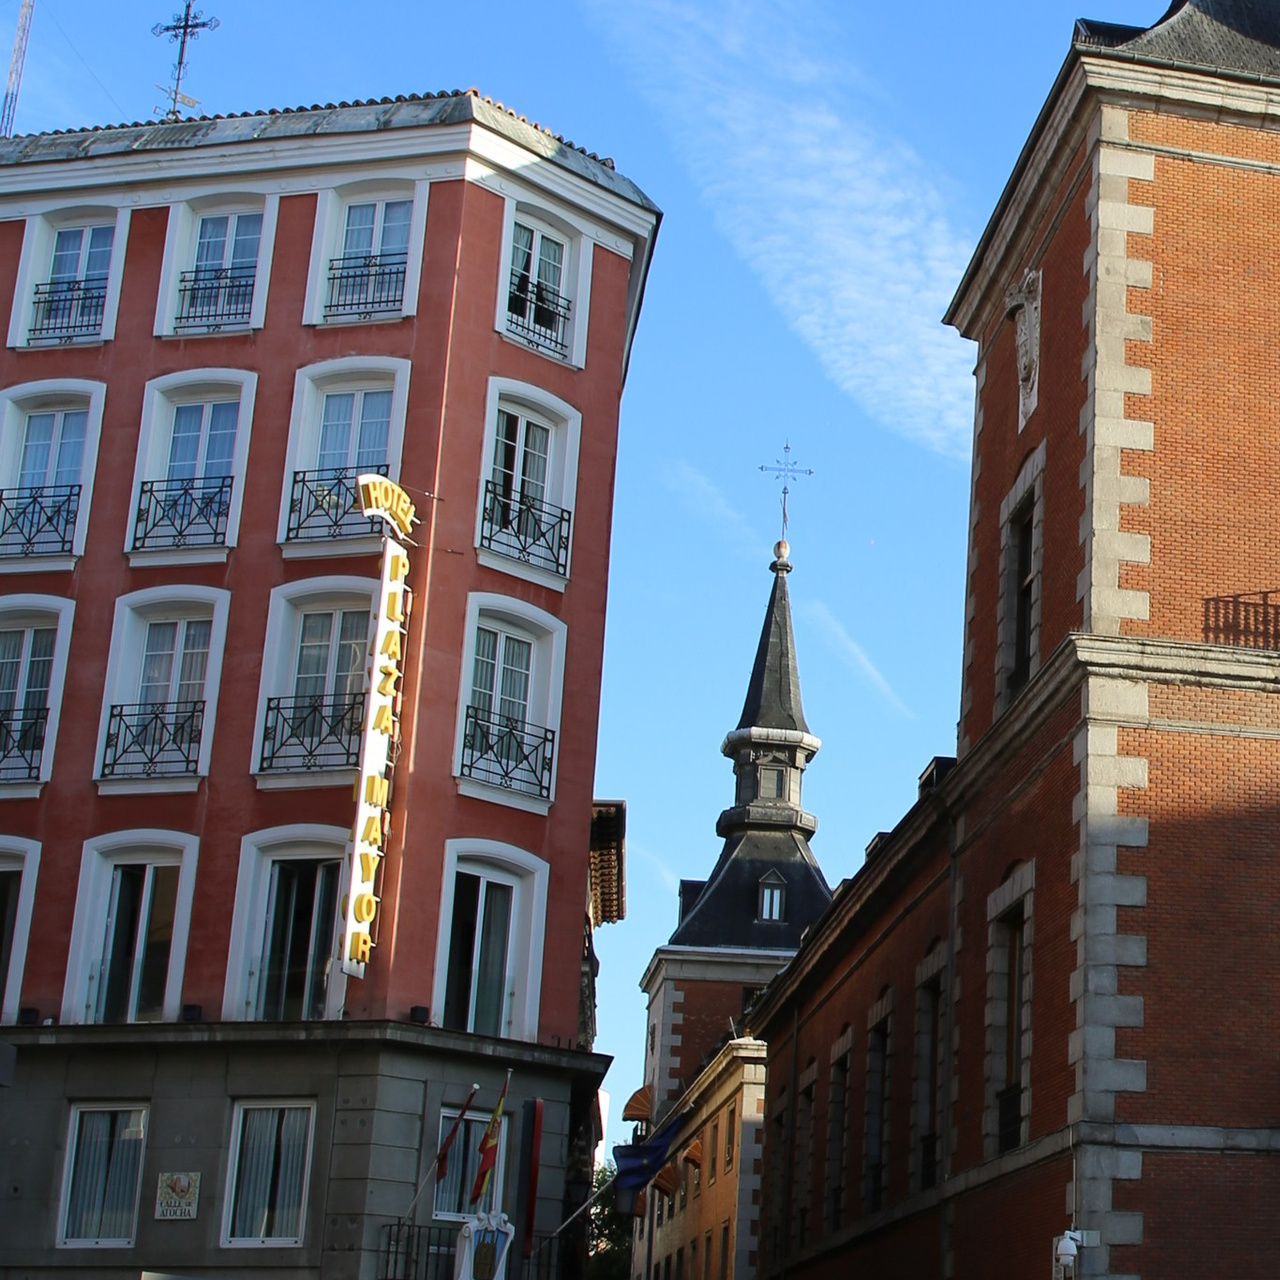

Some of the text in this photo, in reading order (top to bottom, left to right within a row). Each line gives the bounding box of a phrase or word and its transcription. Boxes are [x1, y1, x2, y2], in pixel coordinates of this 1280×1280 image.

[363, 480, 416, 534] HOTEL
[350, 554, 410, 964] PLAZA MAYOR
[160, 1200, 182, 1208] CALLE
[160, 1208, 192, 1218] ATOCHA
